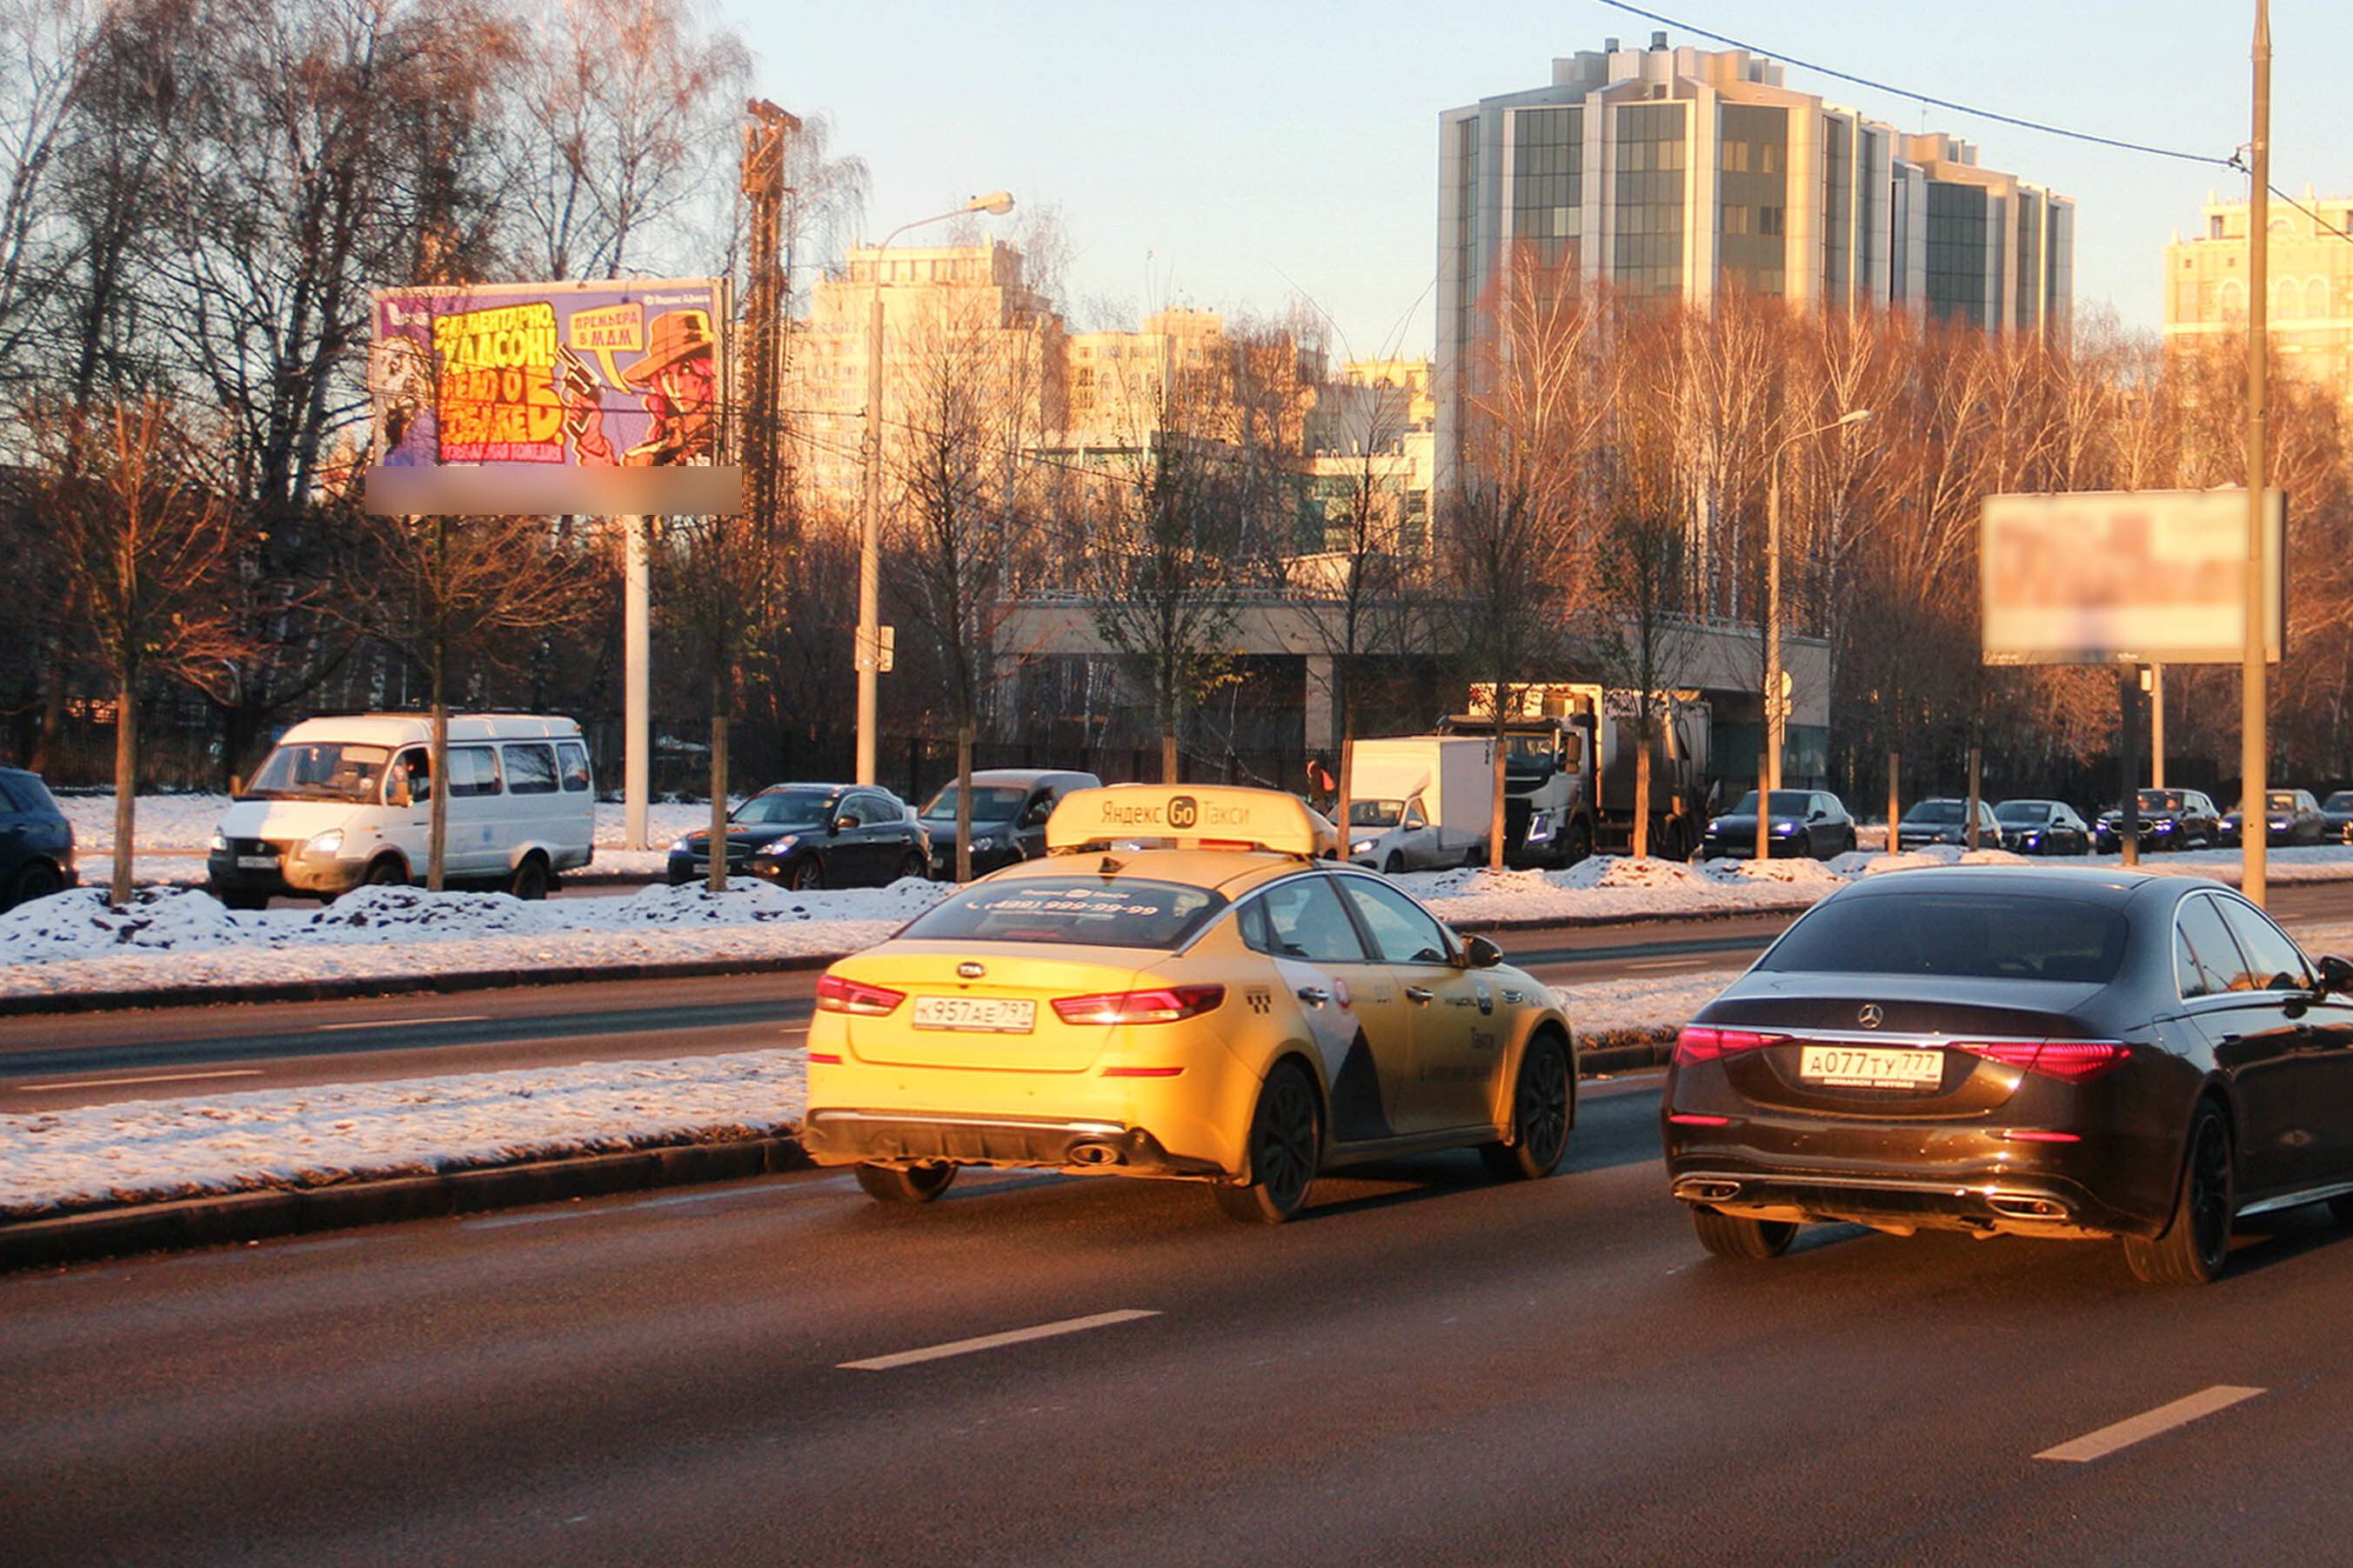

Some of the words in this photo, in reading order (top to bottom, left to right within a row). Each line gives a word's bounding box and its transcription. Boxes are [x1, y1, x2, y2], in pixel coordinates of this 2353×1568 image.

[575, 311, 638, 330] ПРЕМЬЕРА
[591, 329, 632, 346] МДМ
[1100, 800, 1163, 825] Яндекс
[1170, 799, 1194, 824] Go
[1202, 800, 1250, 824] Такси
